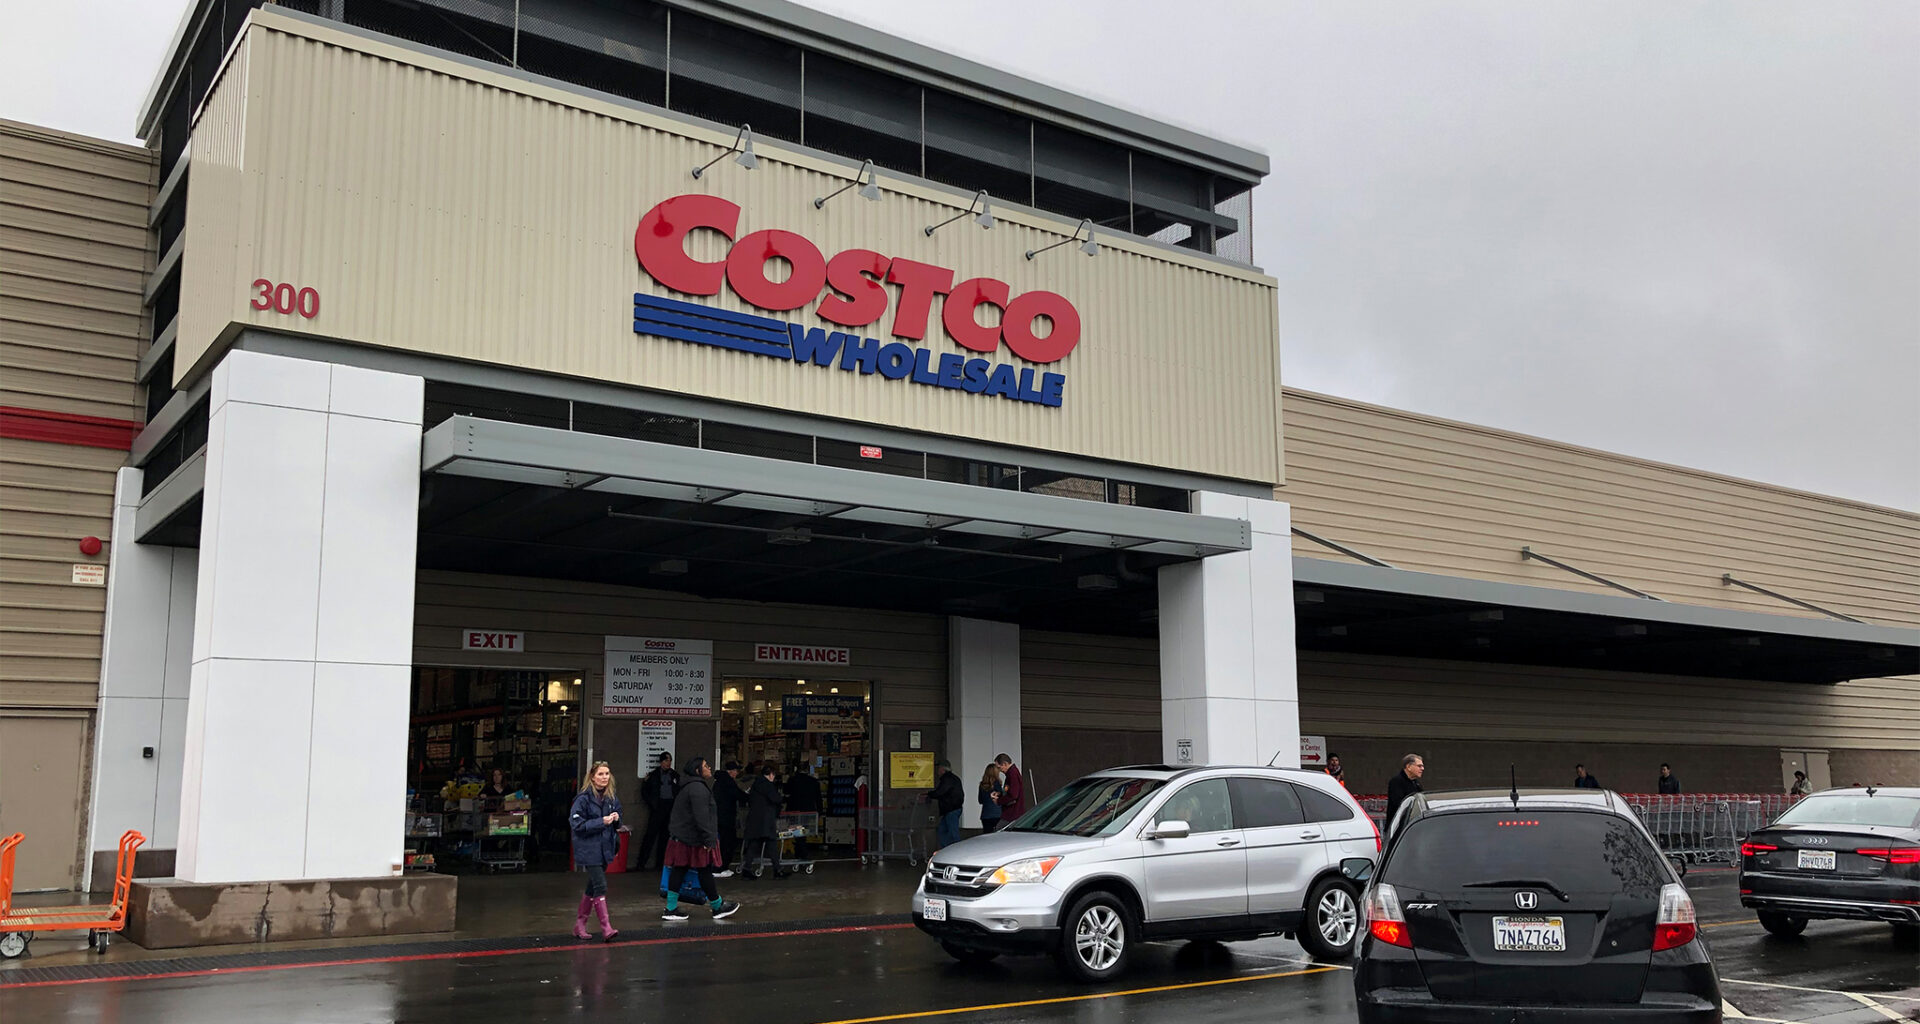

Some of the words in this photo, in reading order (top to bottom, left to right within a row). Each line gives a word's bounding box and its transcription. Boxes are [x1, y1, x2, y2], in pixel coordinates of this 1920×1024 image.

[634, 194, 1081, 364] COSTCO
[251, 278, 320, 319] 300
[788, 322, 1066, 408] WHOLESALE
[469, 632, 518, 649] EXIT
[629, 655, 668, 664] MEMBERS
[669, 656, 690, 665] ONLY
[758, 646, 848, 663] ENTRANCE
[613, 668, 632, 676] MON
[638, 668, 651, 677] FRI
[664, 669, 684, 678] 10:00
[689, 670, 705, 679] 8:30
[612, 681, 654, 690] SATURDAY
[667, 682, 684, 691] 9:30
[689, 683, 705, 692] 7:00
[612, 695, 644, 704] SUNDAY
[663, 696, 683, 705] 10:00
[688, 697, 704, 706] 7:00
[786, 698, 804, 706] FREE
[1499, 929, 1560, 946] 7NAZ764
